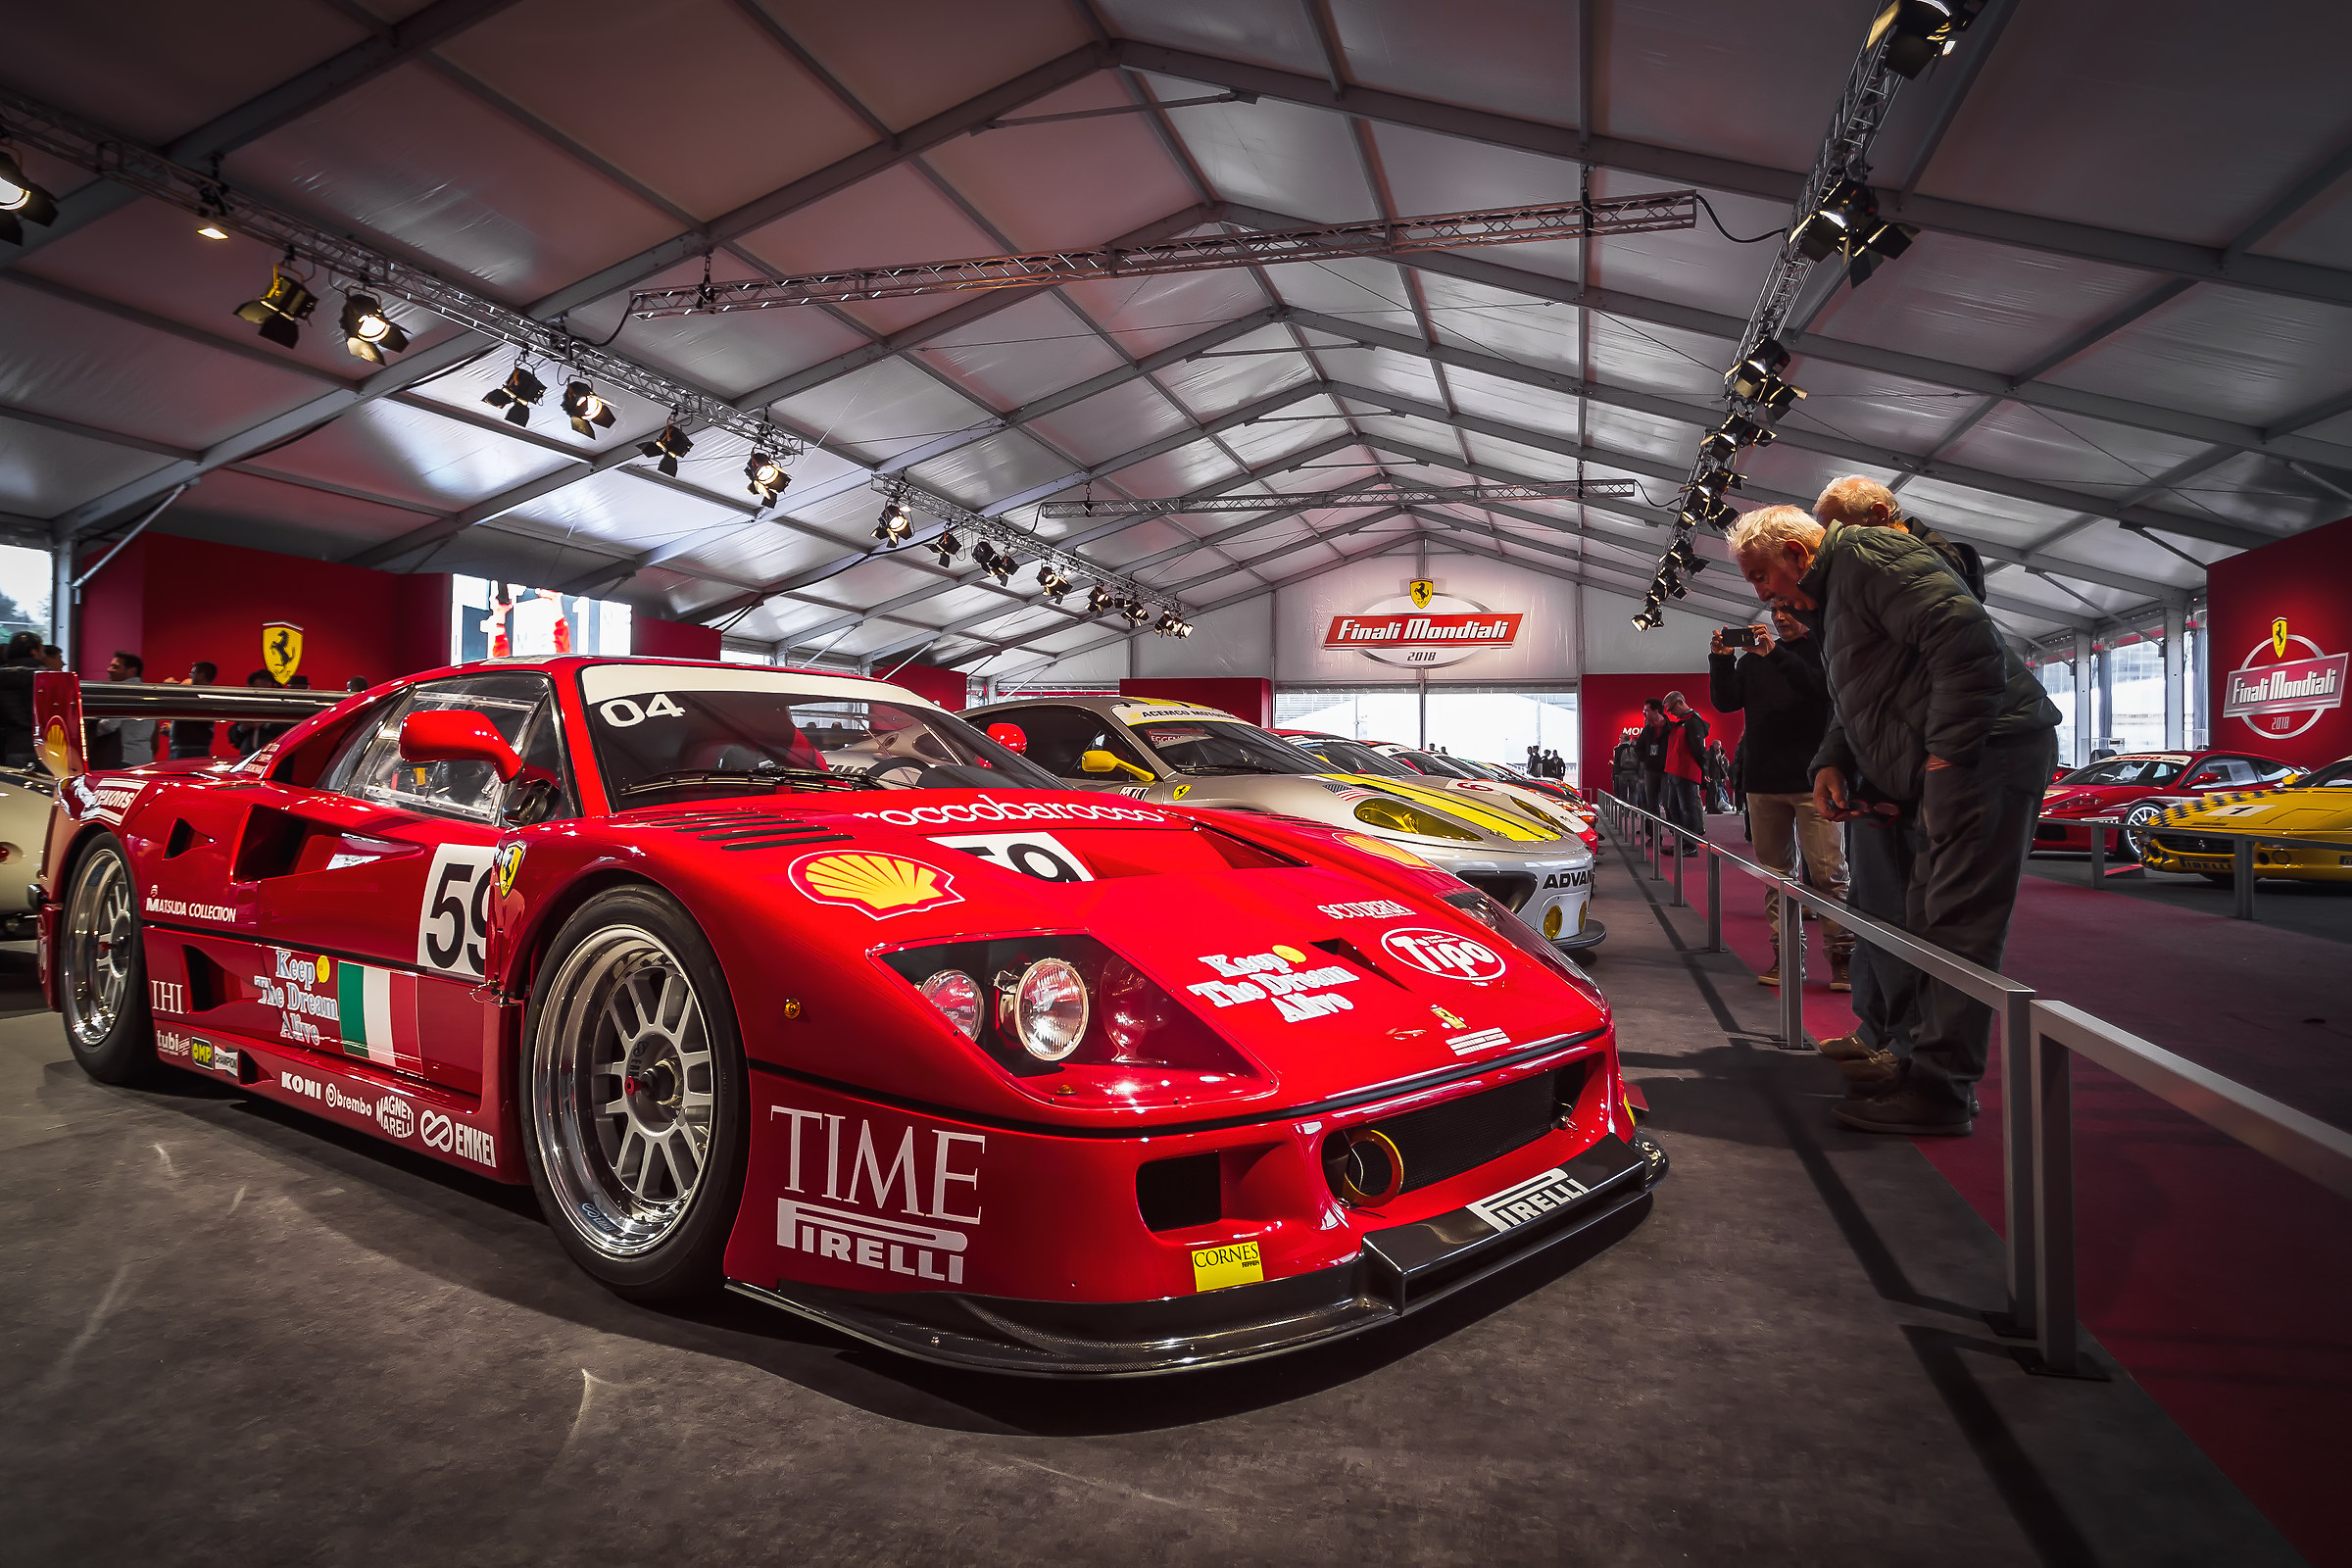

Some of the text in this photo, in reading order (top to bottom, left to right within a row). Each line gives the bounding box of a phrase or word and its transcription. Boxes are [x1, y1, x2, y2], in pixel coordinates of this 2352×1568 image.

[1338, 618, 1509, 640] Finali Mondiali
[1406, 652, 1437, 662] 2018
[2232, 668, 2336, 704] Finali Mondiali
[600, 693, 686, 727] 04
[2272, 716, 2289, 730] 2018
[853, 795, 1165, 826] roccobarocco
[2230, 807, 2253, 815] 1
[146, 898, 236, 922] MATSUDA COLLECTION
[1317, 900, 1412, 919] SCUDERIA
[275, 950, 316, 991] Keep
[1198, 954, 1294, 978] Keep
[1388, 936, 1495, 978] Tipo
[151, 980, 183, 1013] IHI
[254, 975, 339, 1021] The Dream
[1186, 966, 1360, 1007] The Dream
[1270, 993, 1354, 1023] Alive
[157, 1030, 179, 1052] tubi
[280, 1011, 320, 1046] Alive
[281, 1071, 321, 1100] KONI
[336, 1089, 372, 1116] brembo
[455, 1122, 497, 1167] ENKEI
[770, 1105, 985, 1224] TIME
[1465, 1168, 1590, 1233] PIRELLI
[777, 1198, 967, 1284] PIRELLI
[1195, 1244, 1258, 1267] CORNES
